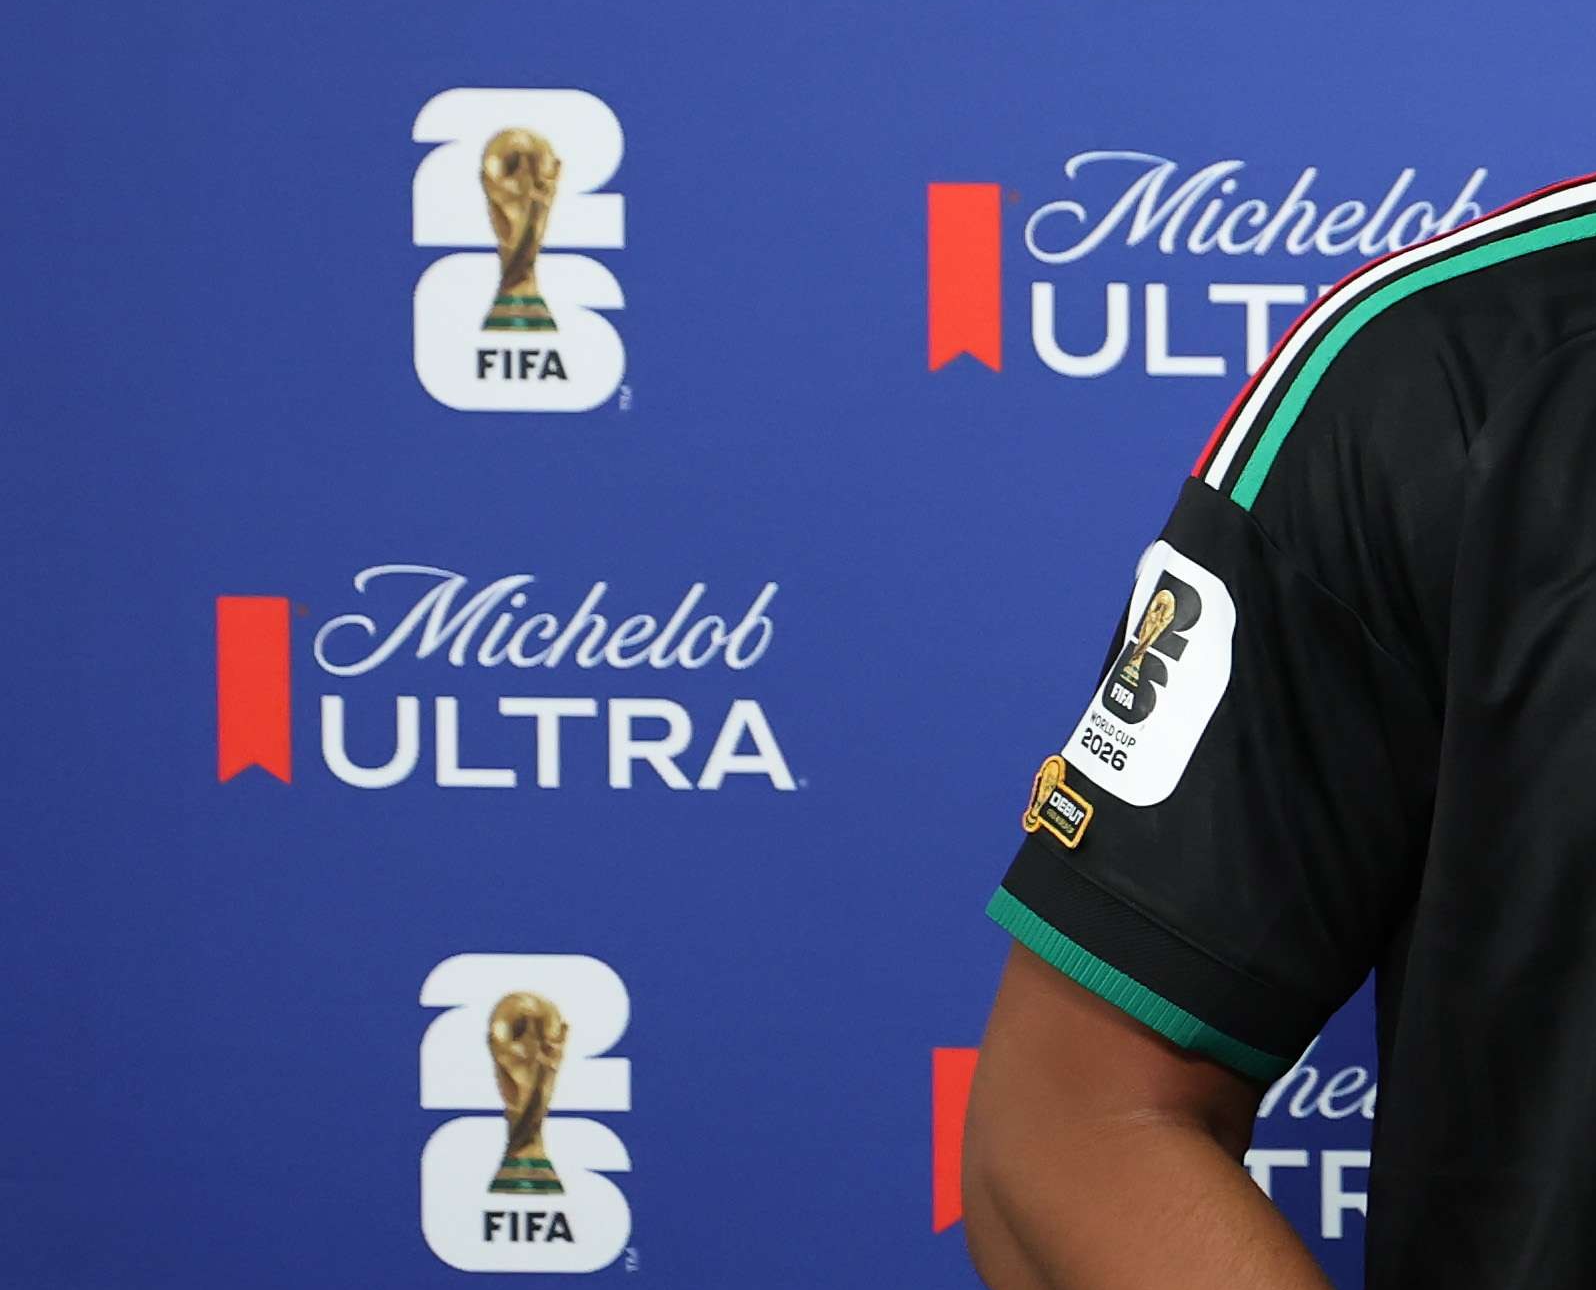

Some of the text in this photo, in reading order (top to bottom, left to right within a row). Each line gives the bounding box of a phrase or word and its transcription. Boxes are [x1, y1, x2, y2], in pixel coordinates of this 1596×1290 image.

[1024, 150, 1488, 264] Michelob
[1031, 281, 1333, 377] ULT
[478, 350, 567, 379] FIFA
[312, 565, 777, 675] Michelob
[1110, 682, 1135, 710] FIFA
[321, 695, 795, 790] ULTRA
[1080, 727, 1128, 772] 2026
[1090, 711, 1136, 749] WORLD CUP
[1049, 791, 1085, 826] DEBUT
[485, 1212, 573, 1242] FIFA
